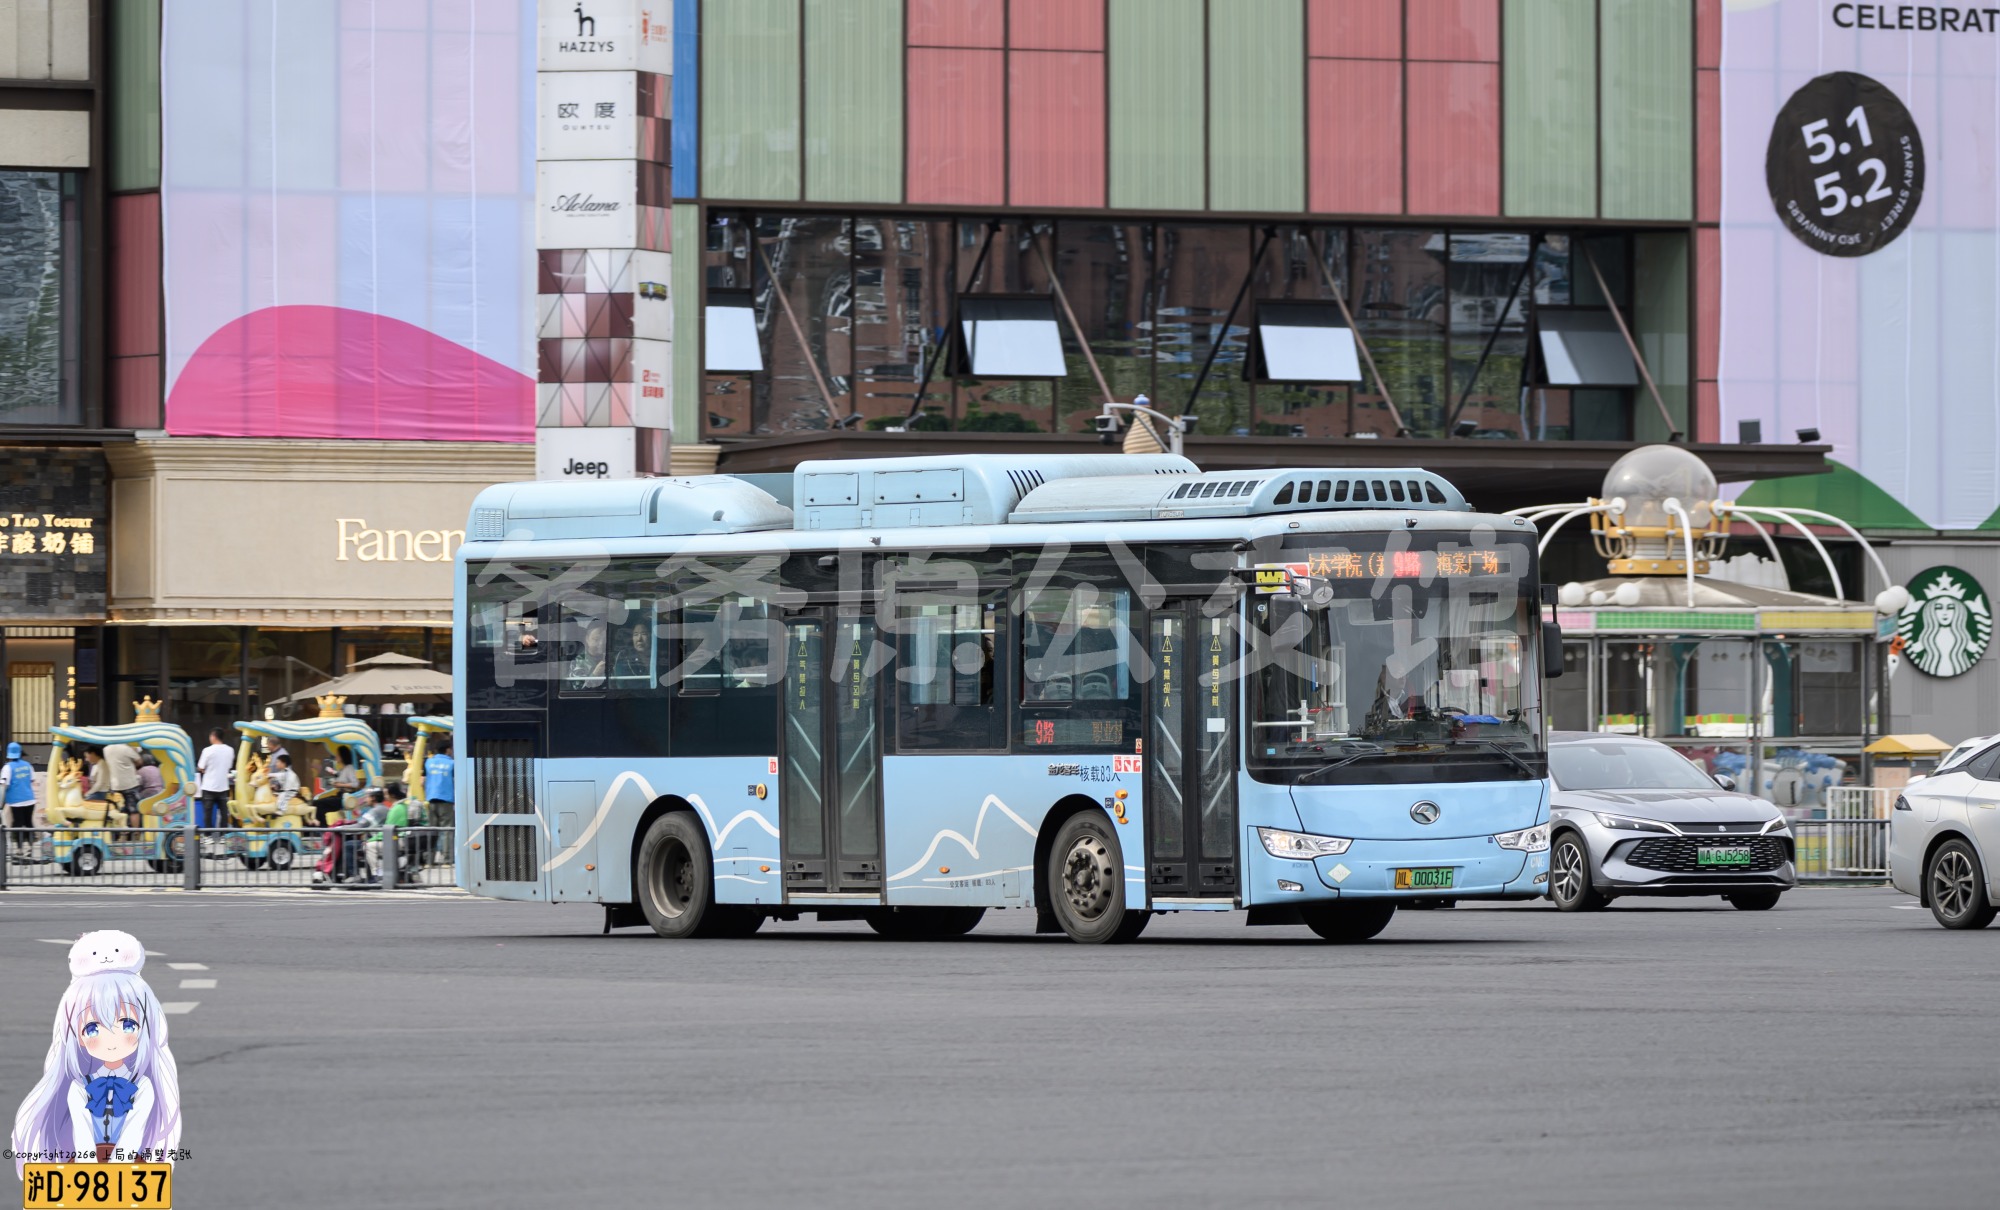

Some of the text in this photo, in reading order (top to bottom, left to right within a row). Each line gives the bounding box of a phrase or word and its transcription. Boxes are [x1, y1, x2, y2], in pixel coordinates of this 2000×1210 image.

[1832, 3, 2000, 33] CELEBRAT
[559, 41, 615, 53] HAZZYS
[557, 102, 616, 119] 欧度
[1801, 105, 1873, 164] 5.1
[1813, 157, 1893, 217] 5.2
[1879, 135, 1915, 232] STARRY STREET
[563, 457, 608, 479] Jeep
[1436, 550, 1499, 577] 海棠广场
[1035, 719, 1055, 745] 9路
